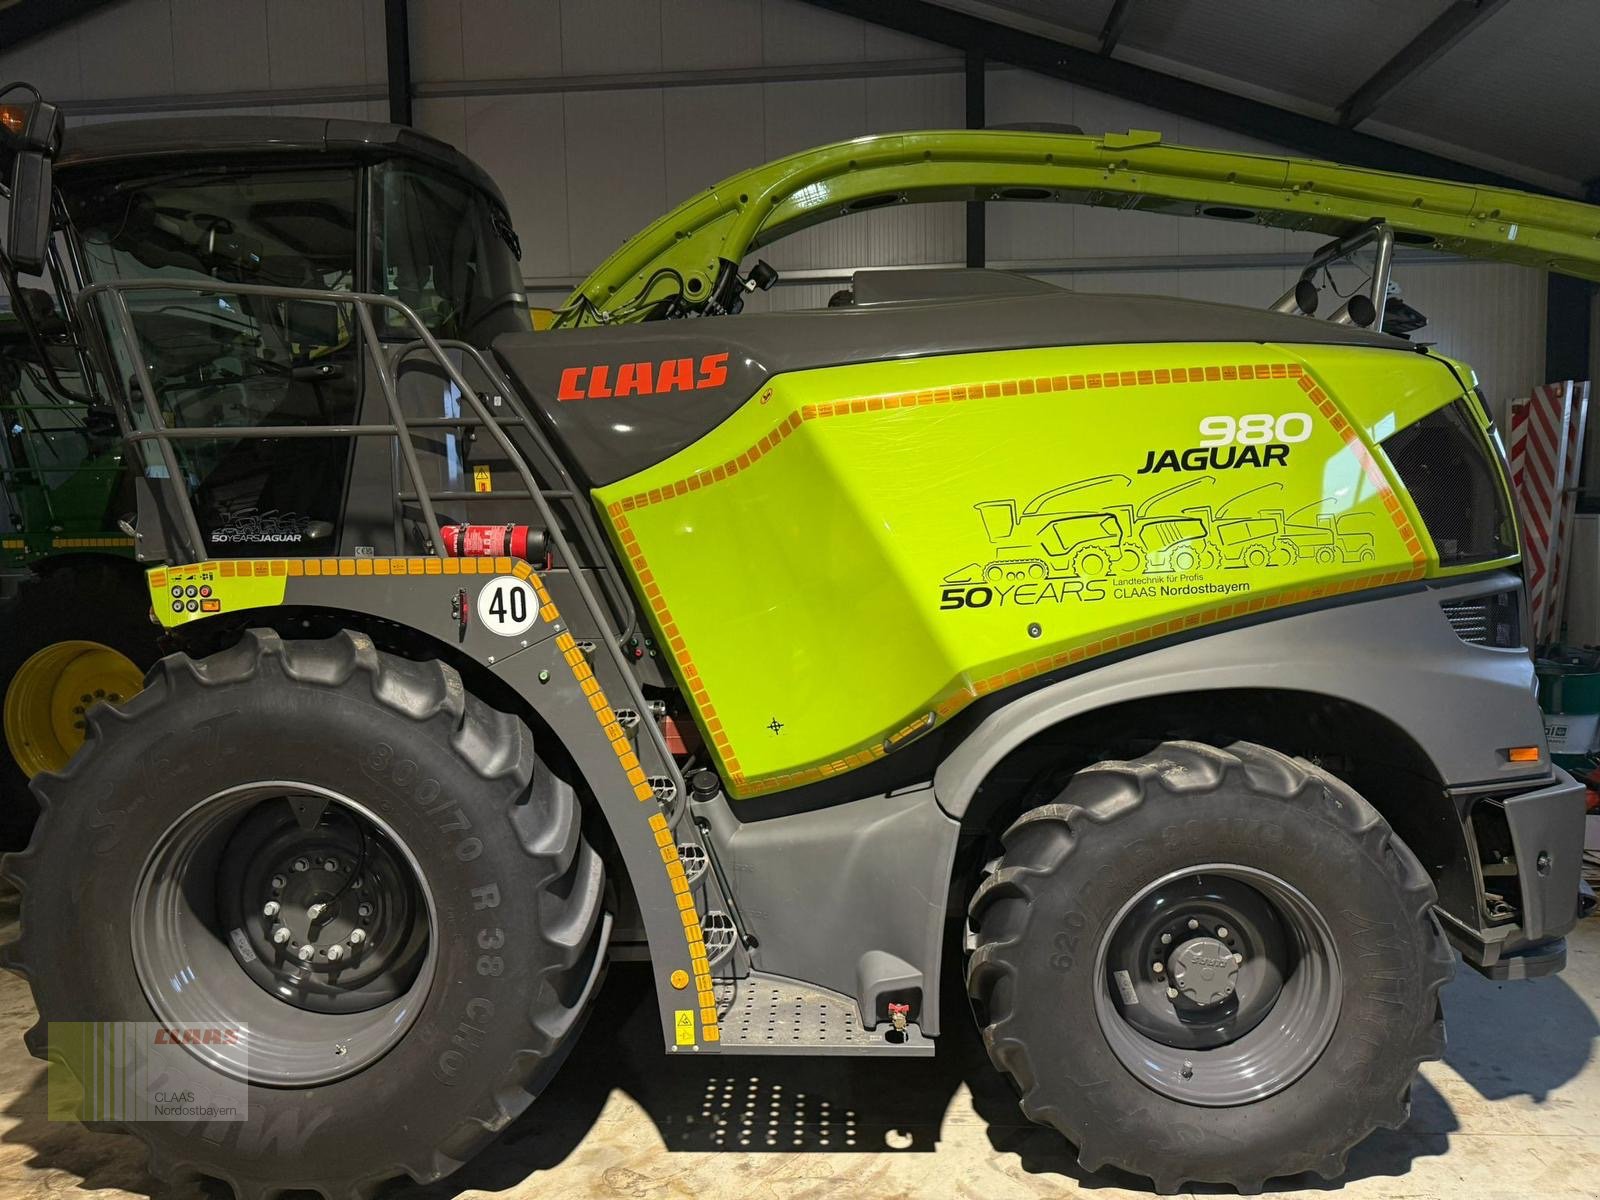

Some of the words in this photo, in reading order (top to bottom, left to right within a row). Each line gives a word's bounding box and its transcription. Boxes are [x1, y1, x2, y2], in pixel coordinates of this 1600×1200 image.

[557, 352, 729, 402] CLAAS
[1199, 412, 1313, 448] 980
[1137, 444, 1290, 475] JAGUAR
[1112, 577, 1164, 586] Landtechnik
[1166, 574, 1177, 584] für
[1180, 573, 1204, 582] Profis
[1113, 586, 1157, 599] CLAAS
[1160, 582, 1250, 597] Nordostbayern
[489, 586, 527, 623] 40
[367, 742, 484, 862] 800/70
[471, 882, 501, 911] R
[476, 928, 505, 977] 38
